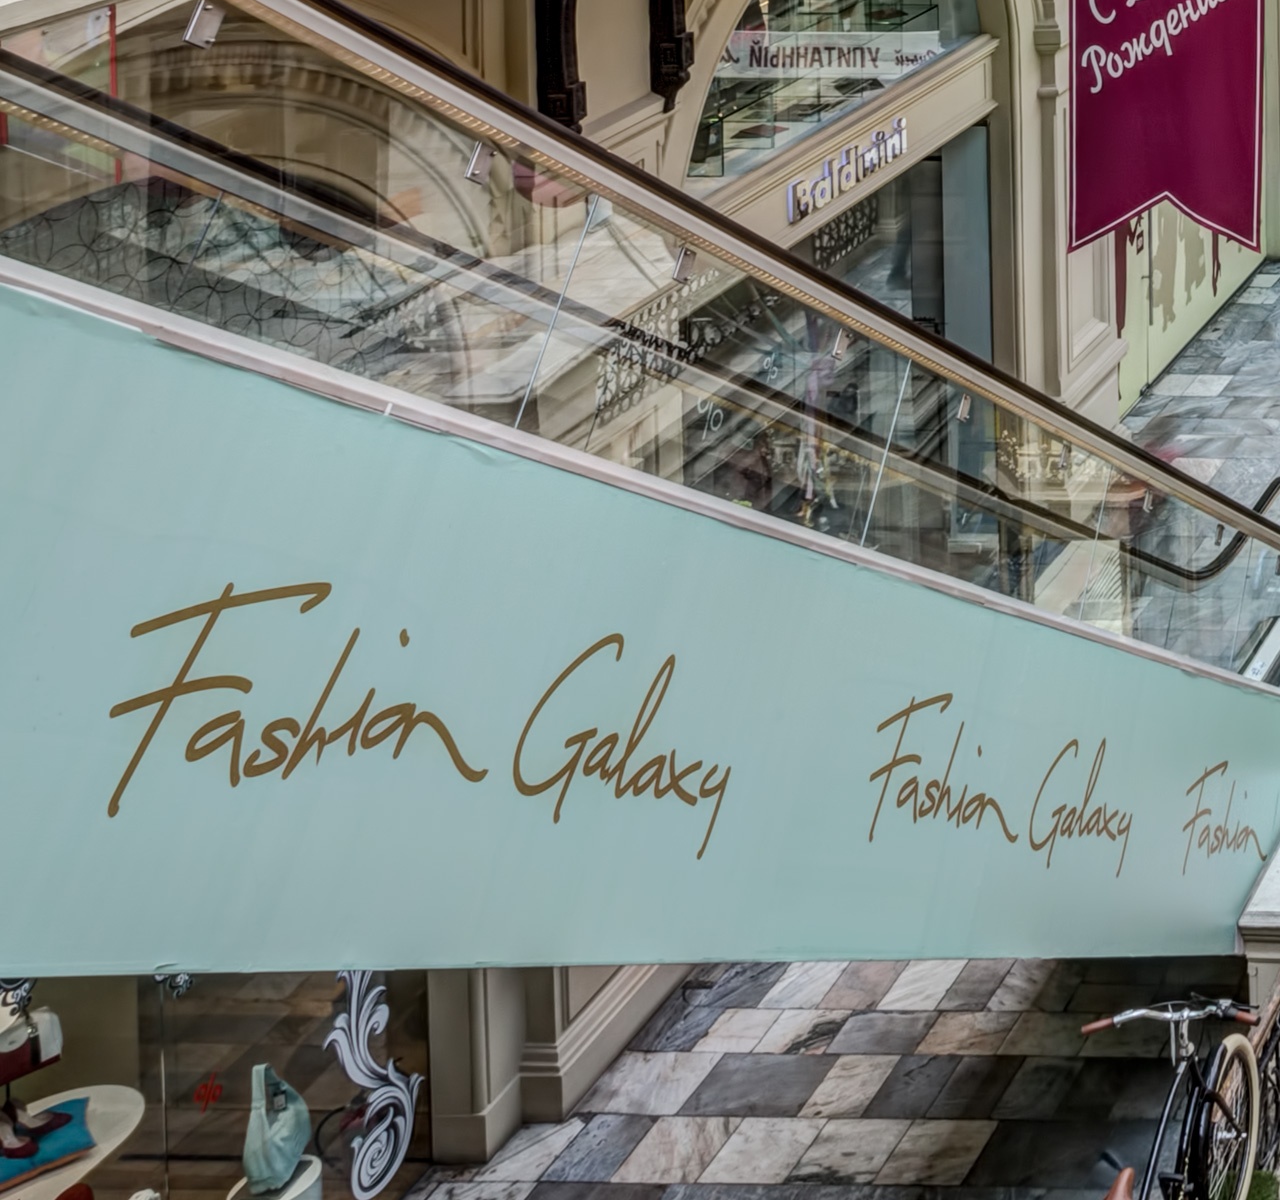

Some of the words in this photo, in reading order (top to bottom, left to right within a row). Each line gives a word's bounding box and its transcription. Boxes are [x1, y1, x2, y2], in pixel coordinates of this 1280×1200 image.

[787, 117, 908, 224] Baldinini
[107, 581, 491, 818] Fashion
[512, 632, 734, 860] Galaxy
[868, 692, 1019, 843] Fashion
[1028, 737, 1133, 879] Galaxy
[1180, 760, 1269, 876] Fashion
